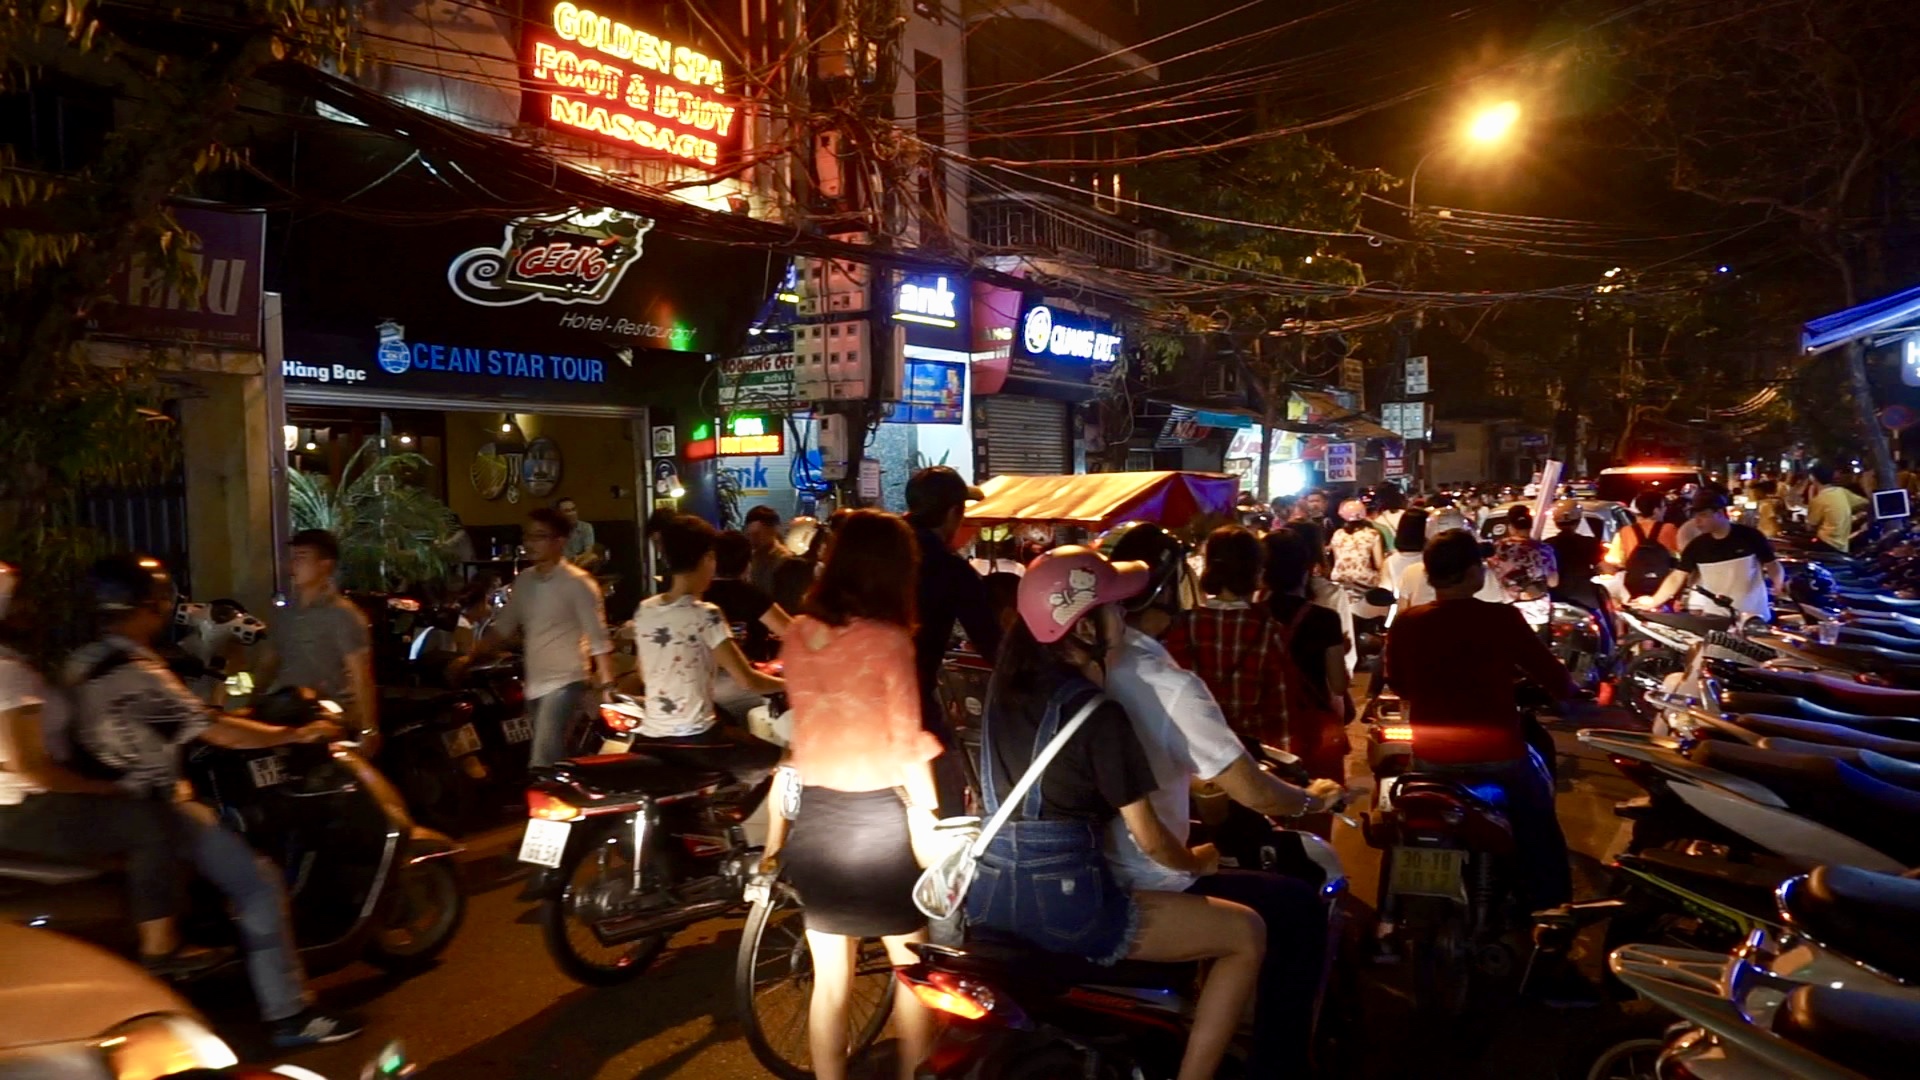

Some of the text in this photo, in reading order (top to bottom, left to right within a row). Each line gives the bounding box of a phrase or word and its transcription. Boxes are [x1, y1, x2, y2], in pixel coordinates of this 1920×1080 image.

[553, 1, 725, 94] GOLDEN SPA
[534, 42, 735, 136] FOOT & BODY
[551, 94, 718, 166] MASSAGE
[559, 311, 697, 341] Hotel-Restaurant
[282, 360, 366, 384] Hàng Bạc
[487, 350, 545, 378] STAR
[549, 356, 604, 383] TOUR
